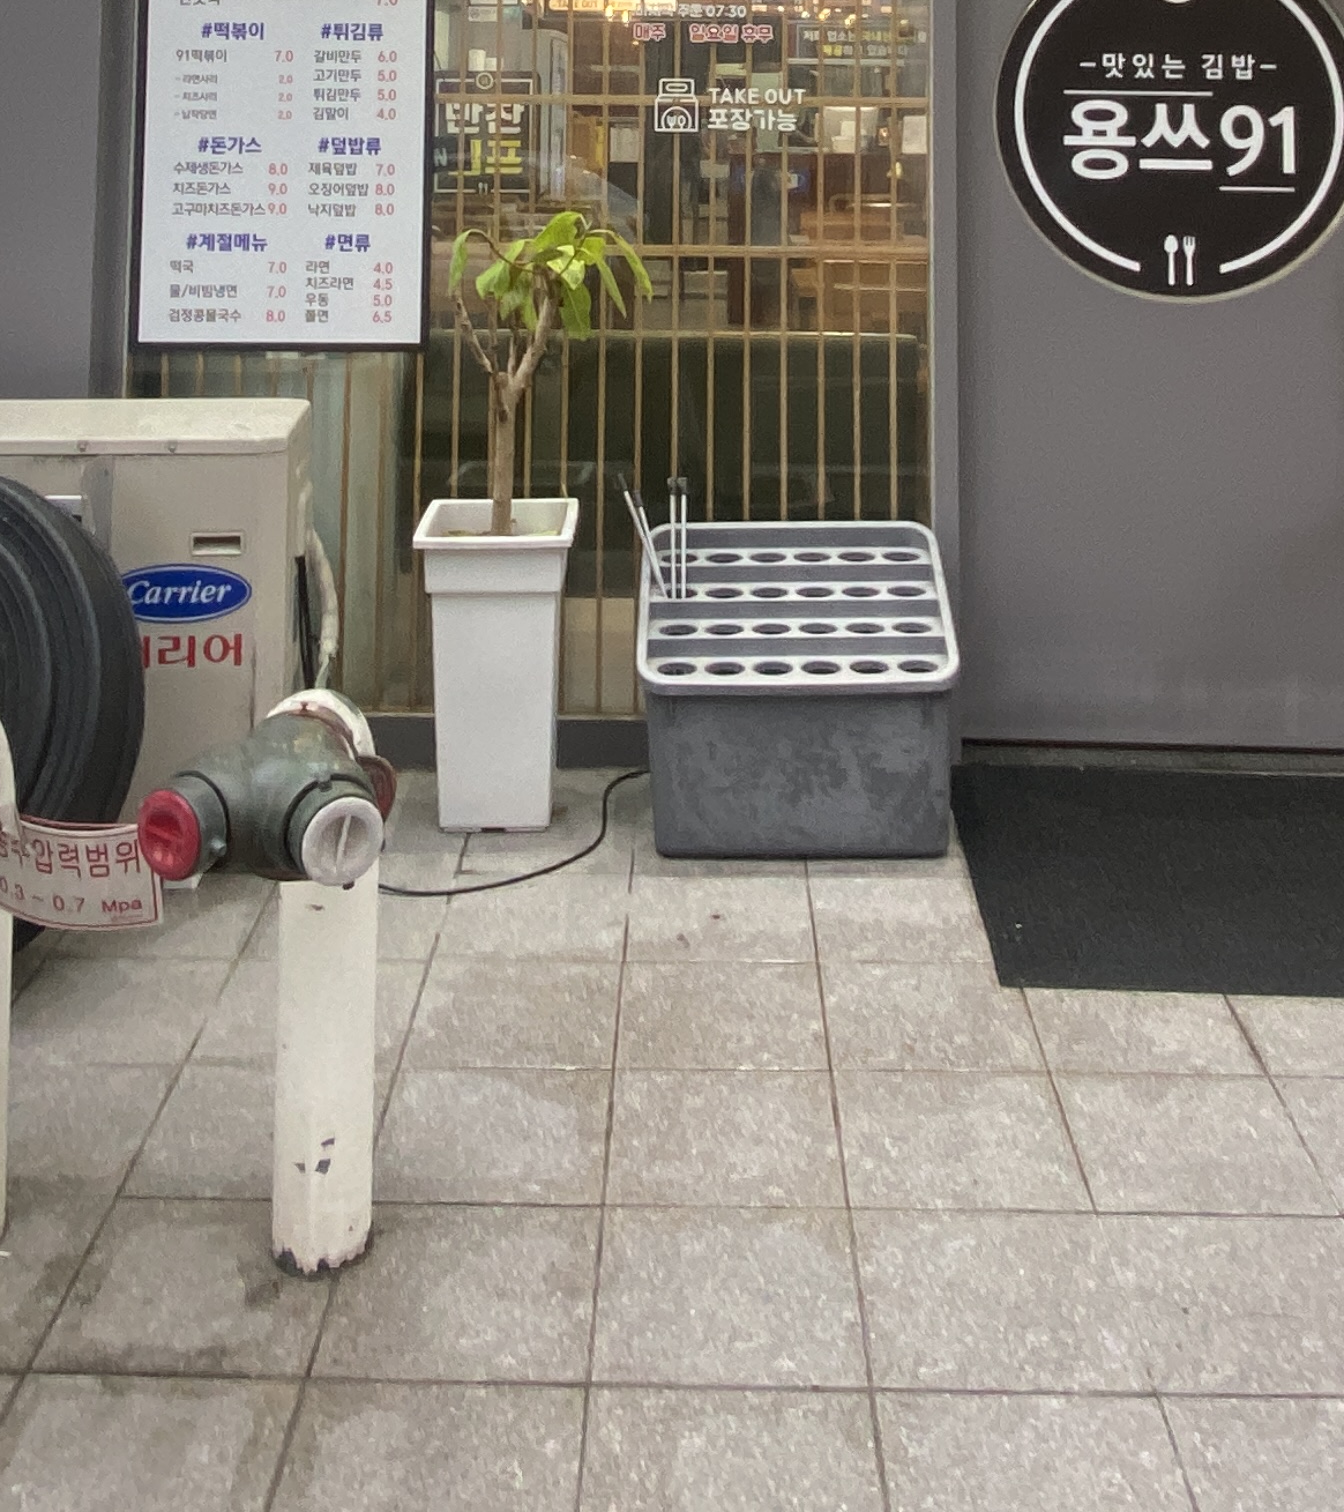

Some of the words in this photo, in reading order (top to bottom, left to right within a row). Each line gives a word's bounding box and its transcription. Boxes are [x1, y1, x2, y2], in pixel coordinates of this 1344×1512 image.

[201, 22, 265, 40] #떡볶이
[321, 23, 384, 41] #튀김류
[633, 23, 666, 41] 매주
[689, 23, 739, 43] 일요일
[741, 24, 773, 42] 휴무
[176, 49, 227, 63] 91떡볶이
[274, 50, 294, 62] 7.0
[313, 50, 362, 64] 갈비만두
[377, 50, 397, 63] 6.0
[1102, 53, 1186, 79] 맛있는
[1202, 54, 1255, 80] 김밥
[313, 69, 362, 83] 고기만두
[377, 69, 397, 82] 5.0
[313, 88, 361, 102] 튀김만두
[377, 88, 397, 101] 5.0
[707, 88, 758, 105] TAKE
[764, 88, 806, 104] OUT
[376, 107, 397, 120] 4.0
[707, 110, 797, 131] 포장가능
[197, 136, 262, 154] #돈가스
[318, 137, 382, 155] #덮밥류
[1063, 99, 1296, 180] 용쓰91
[268, 163, 288, 176] 8.0
[308, 162, 357, 176] 제육덮밥
[376, 164, 396, 176] 7.0
[172, 182, 231, 195] 치즈돈가스
[268, 183, 288, 196] 9.0
[308, 183, 369, 197] 오징어덮밥
[375, 183, 395, 196] 8.0
[171, 203, 266, 217] 고구마치즈돈가스
[268, 203, 287, 216] 9.0
[307, 203, 356, 217] 낙지덮밥
[375, 203, 395, 216] 8.0
[186, 233, 268, 252] #계절메뉴
[324, 234, 371, 252] #면류
[169, 260, 194, 274] 떡국
[268, 262, 287, 274] 7.0
[306, 261, 330, 274] 라면
[373, 262, 394, 275] 4.0
[306, 277, 355, 290] 치즈라면
[373, 278, 393, 291] 4.5
[267, 286, 286, 298] 7.0
[305, 293, 329, 306] 우동
[373, 295, 392, 307] 5.0
[265, 309, 286, 322] 8.0
[372, 311, 392, 323] 6.5
[127, 580, 231, 605] Carrier
[101, 898, 143, 913] Mpa
